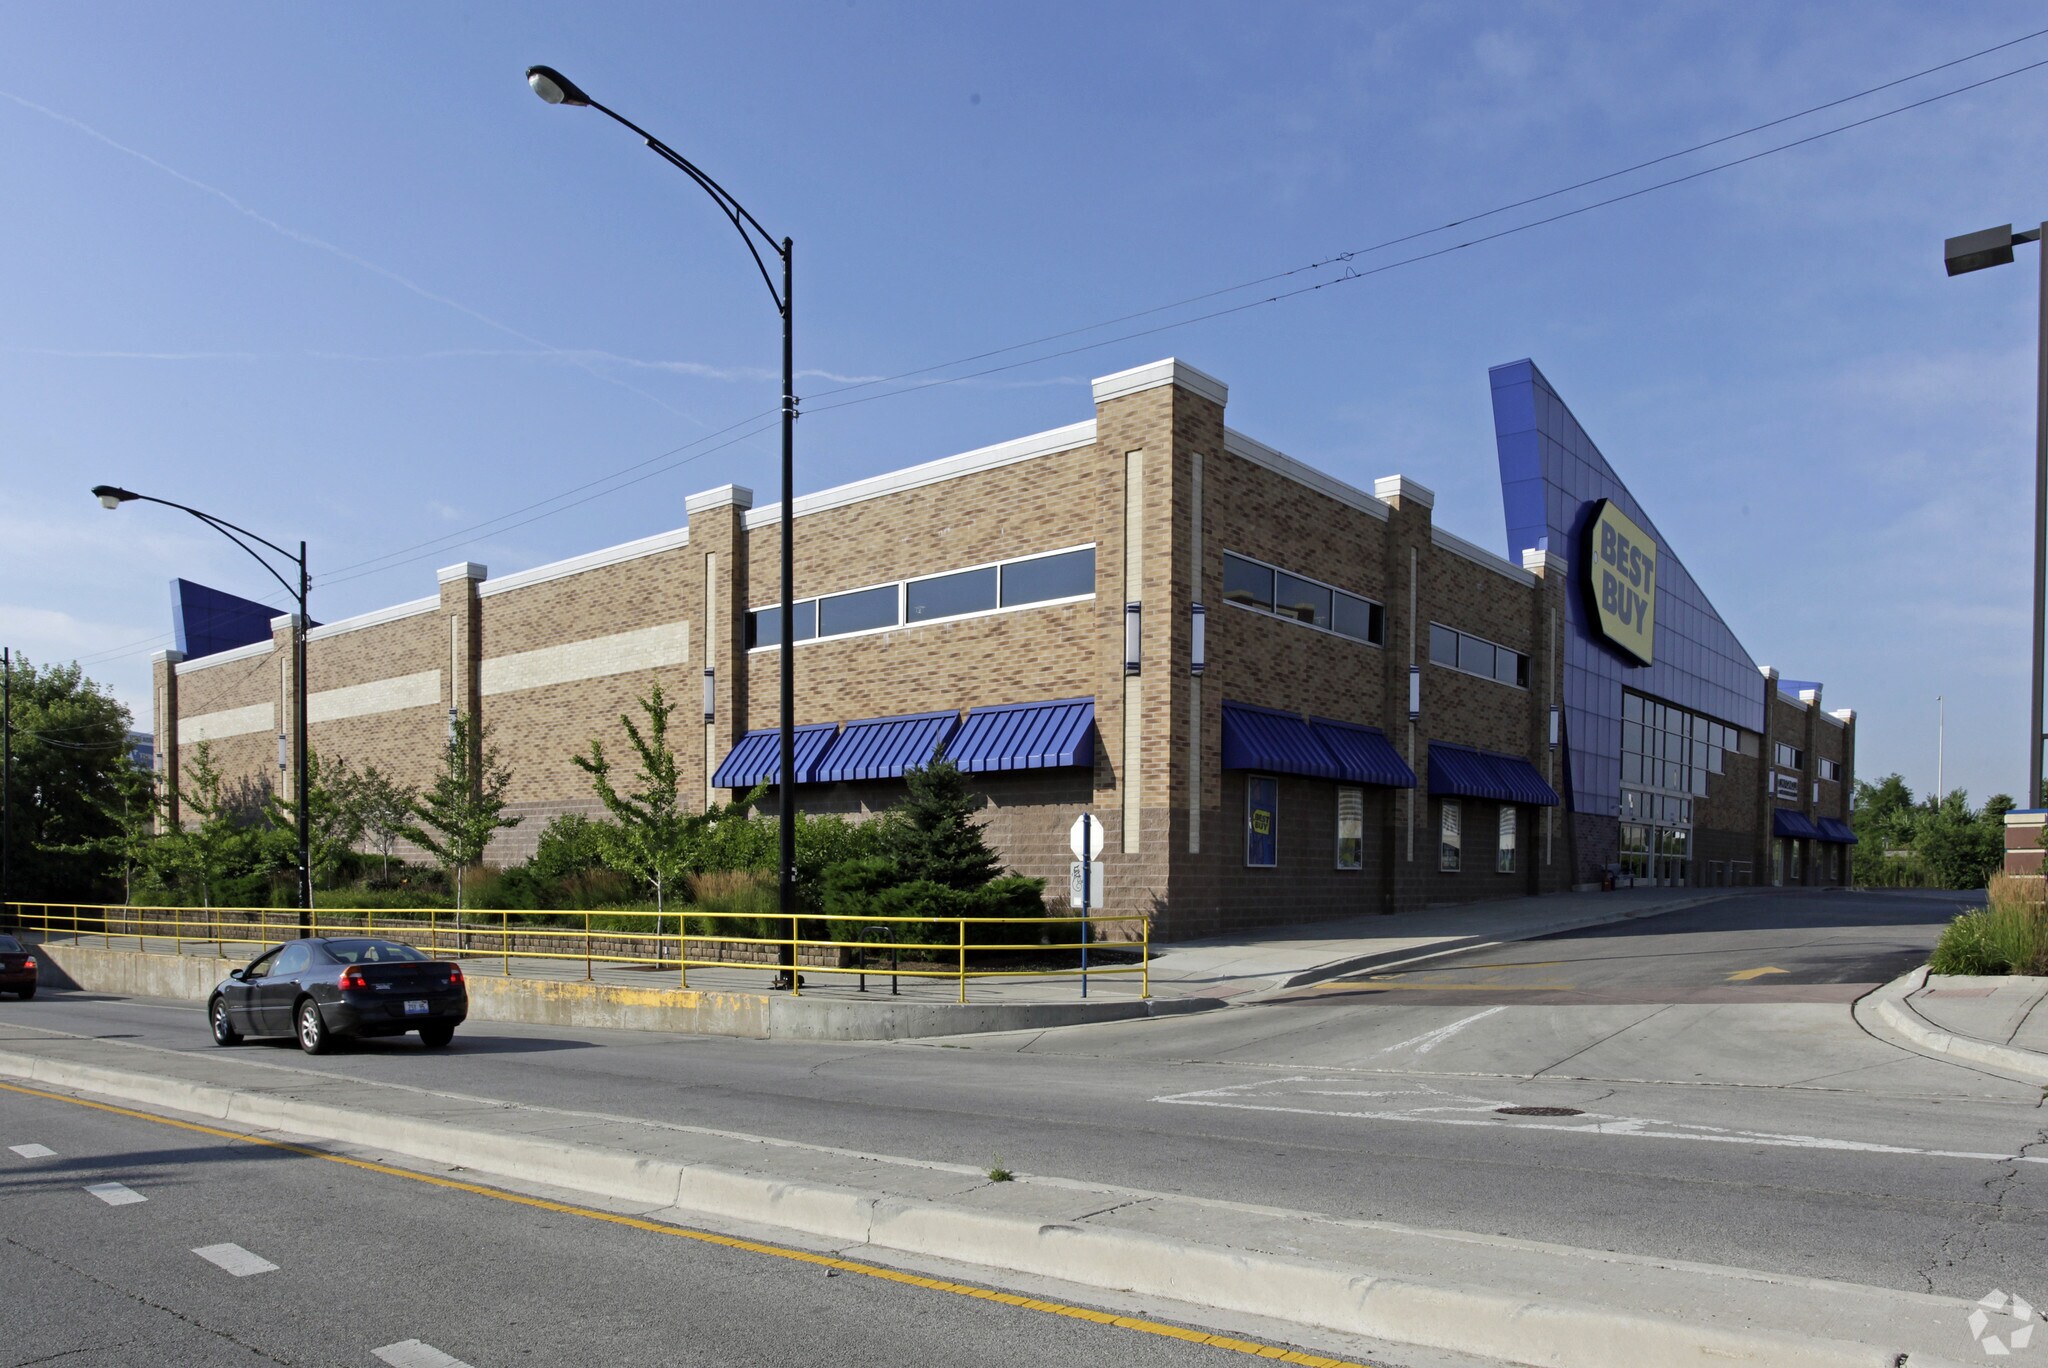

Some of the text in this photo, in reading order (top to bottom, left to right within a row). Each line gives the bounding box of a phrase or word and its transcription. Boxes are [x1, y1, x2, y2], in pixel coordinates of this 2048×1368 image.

[1601, 519, 1654, 595] BEST
[1602, 569, 1648, 635] BUY
[1255, 813, 1269, 823] BEST
[1255, 821, 1268, 830] BUY
